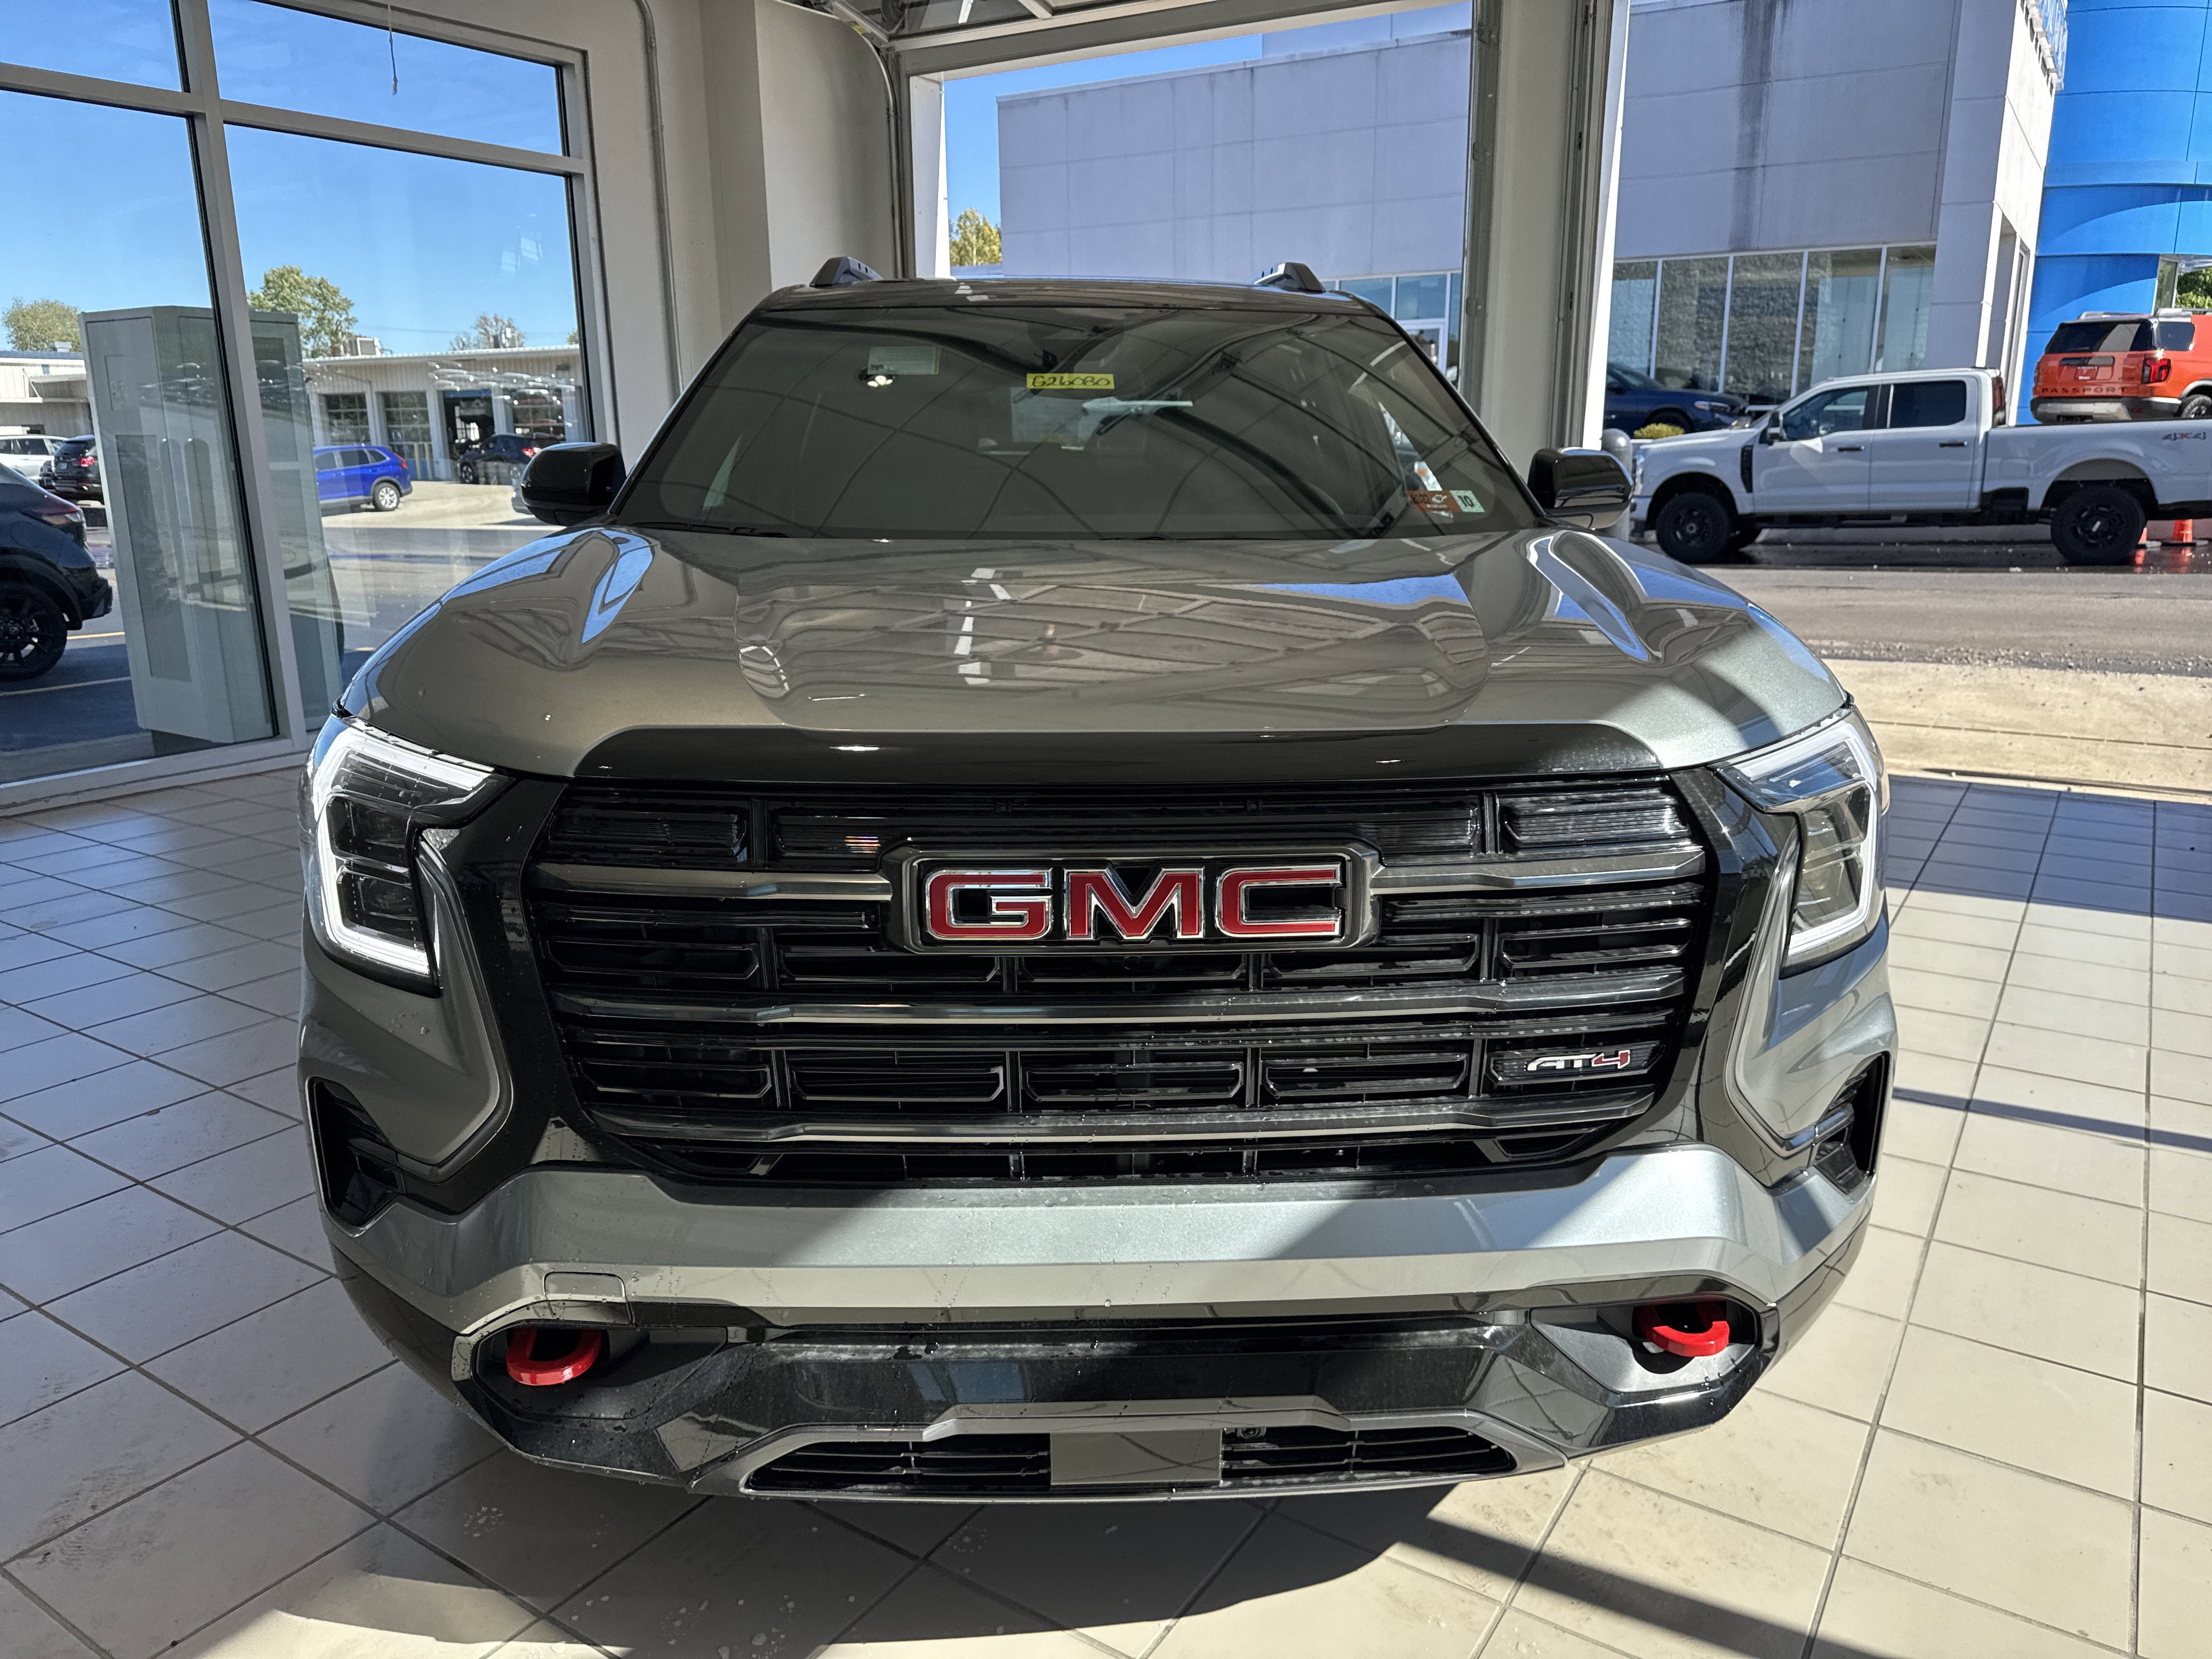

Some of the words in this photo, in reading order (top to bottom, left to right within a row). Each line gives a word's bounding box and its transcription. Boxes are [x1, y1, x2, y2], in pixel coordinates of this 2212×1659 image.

[1032, 375, 1110, 387] G26080
[2041, 386, 2126, 394] PASSPORT
[1457, 495, 1475, 507] 10
[924, 861, 1343, 940] GMC
[1527, 1049, 1630, 1071] AT4
